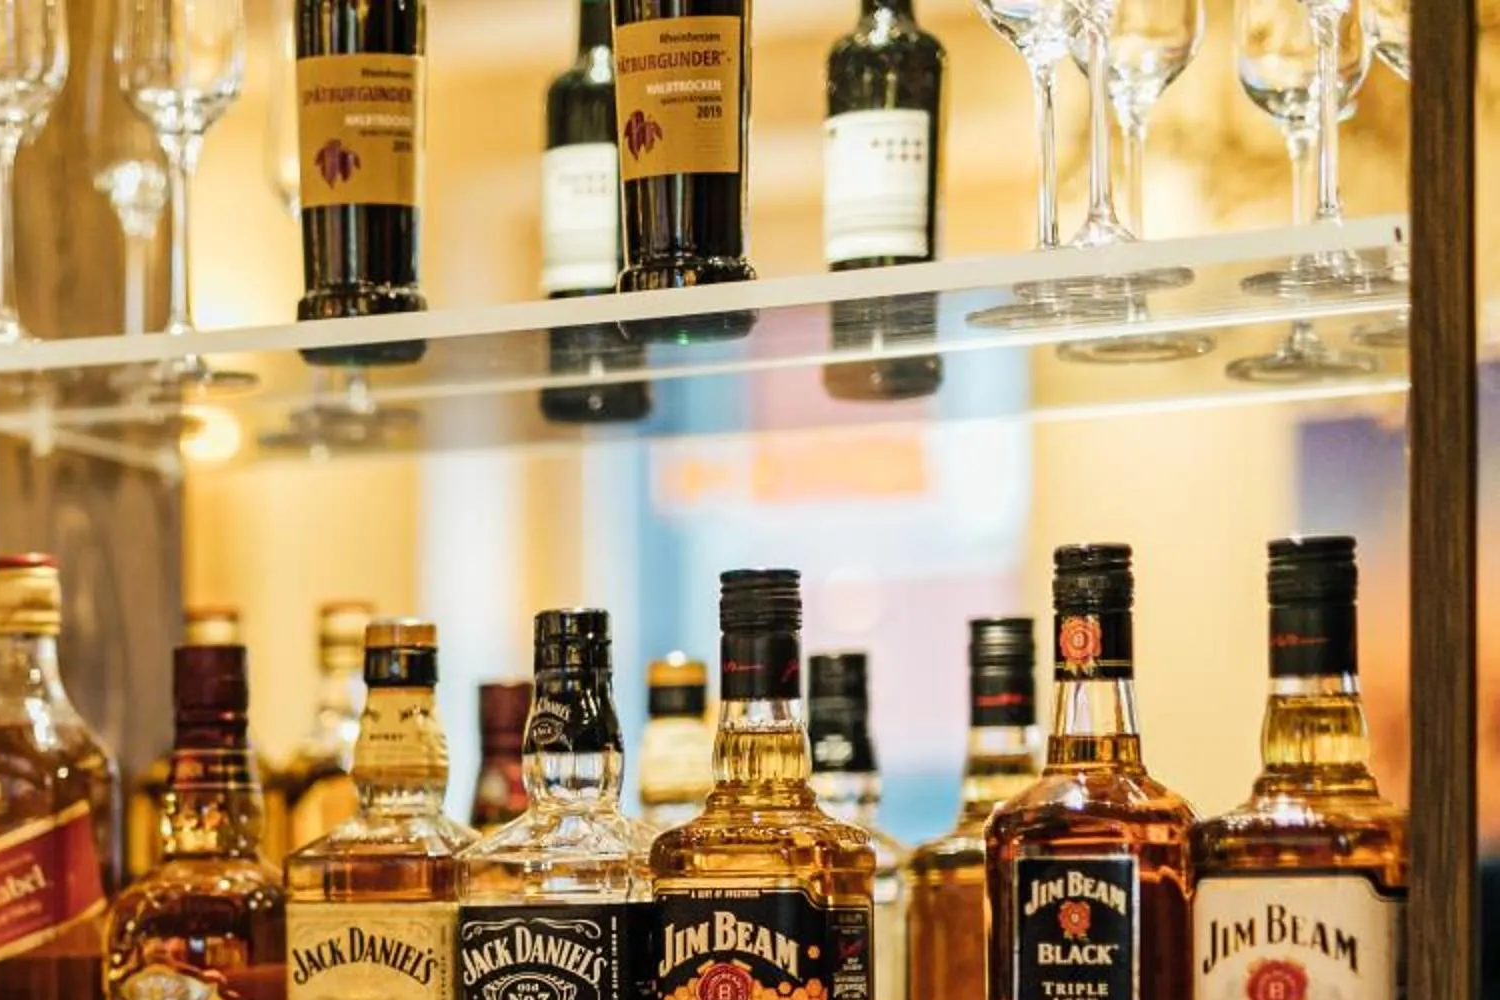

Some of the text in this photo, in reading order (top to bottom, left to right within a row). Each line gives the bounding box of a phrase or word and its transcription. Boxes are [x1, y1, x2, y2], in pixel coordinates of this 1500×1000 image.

[1025, 870, 1127, 916] JIM BEAM
[293, 926, 439, 985] JACK DANIEL'S
[463, 925, 608, 985] JACK DANIEL'S
[659, 910, 802, 979] JIM BEAM
[1037, 943, 1113, 966] BLACK
[1202, 903, 1360, 975] JIM BEAM
[1042, 981, 1109, 997] TRIPLE
